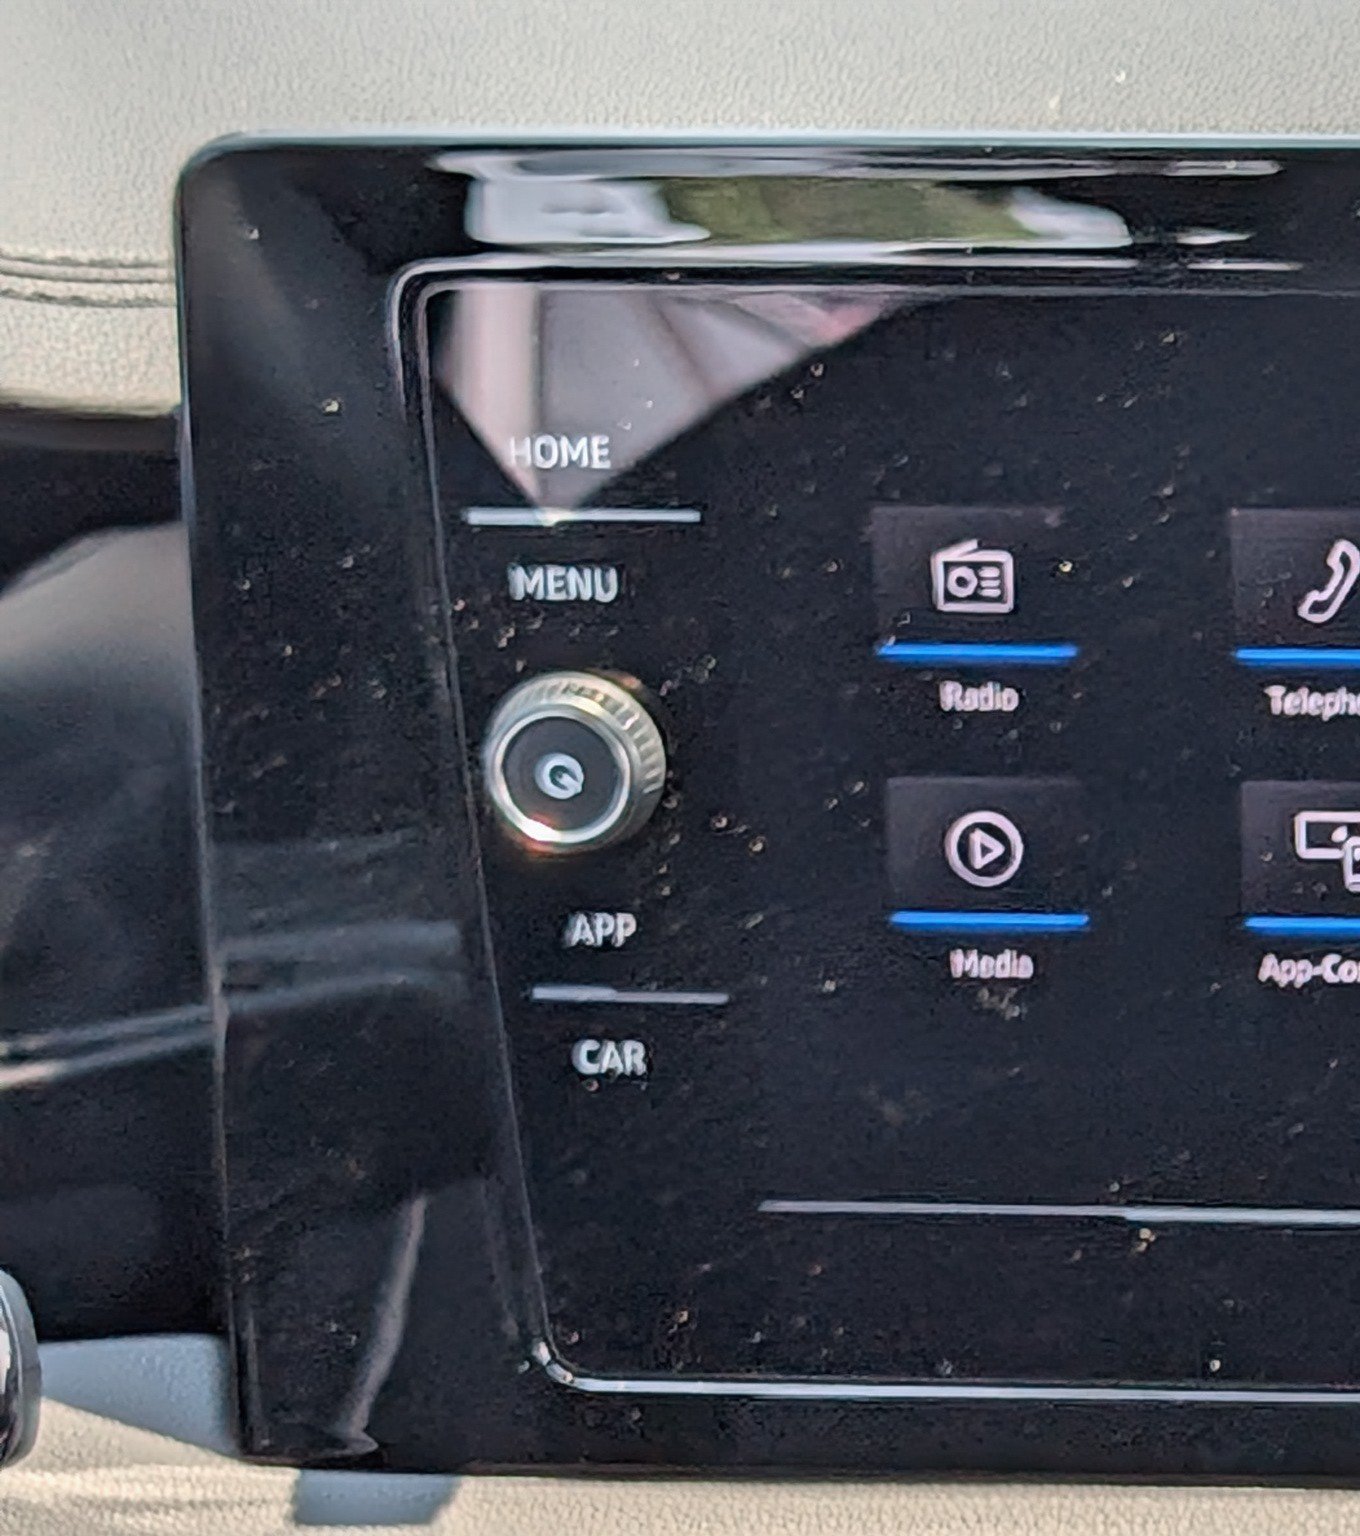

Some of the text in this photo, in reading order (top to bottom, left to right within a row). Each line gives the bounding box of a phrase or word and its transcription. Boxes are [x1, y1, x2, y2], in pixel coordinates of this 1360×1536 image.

[510, 436, 611, 470] HOME
[508, 565, 618, 603] MENU
[939, 681, 1020, 711] Radio
[564, 913, 636, 947] APP
[950, 950, 1034, 978] Media
[573, 1040, 647, 1076] CAR
